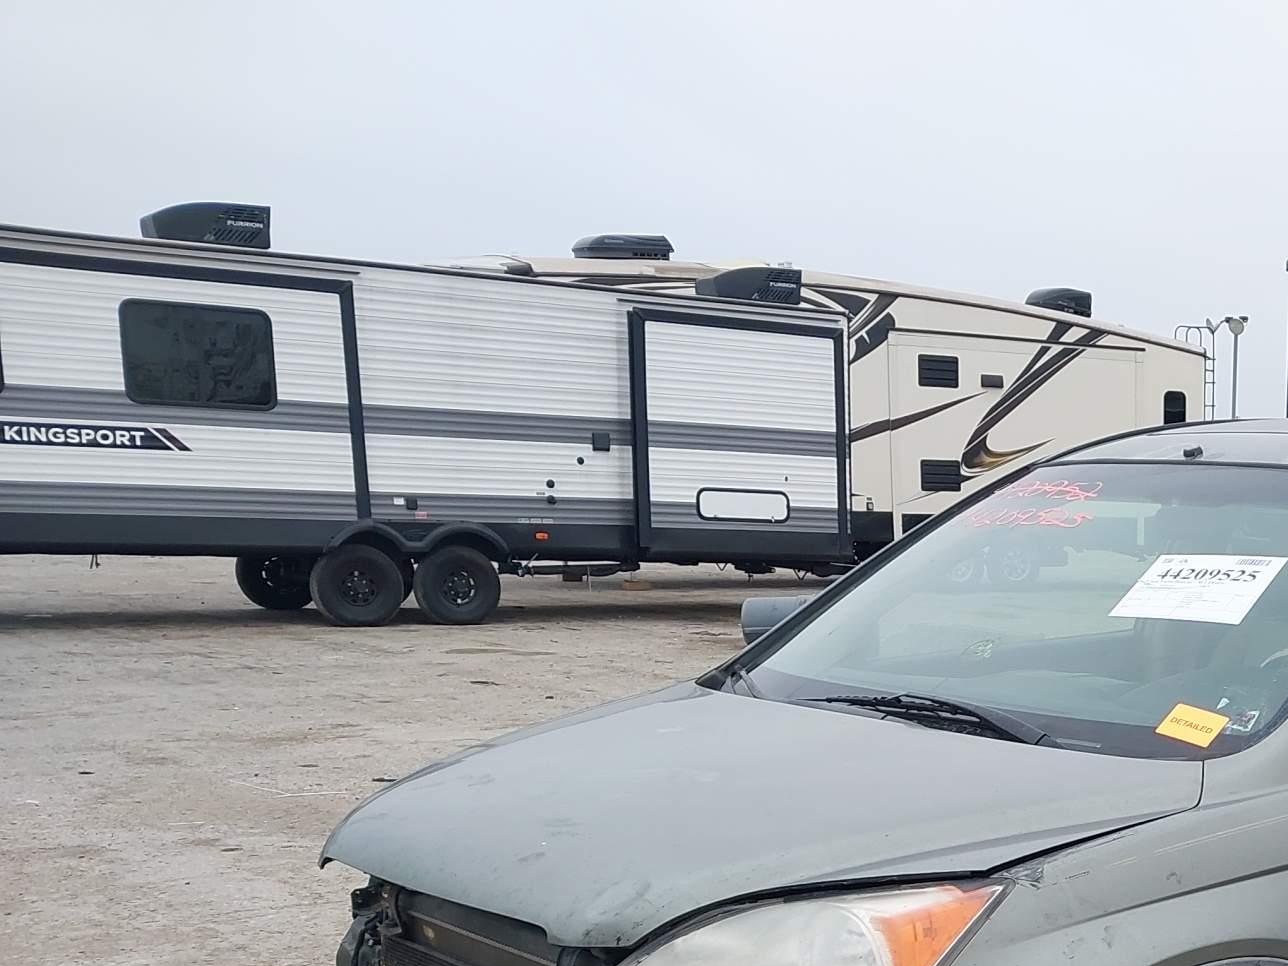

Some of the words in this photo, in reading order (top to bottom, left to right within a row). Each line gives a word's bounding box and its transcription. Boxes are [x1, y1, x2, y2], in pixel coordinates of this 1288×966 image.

[226, 219, 264, 229] FURRION
[3, 425, 145, 446] KINGSPORT
[1156, 567, 1262, 583] 44209525
[1169, 716, 1214, 735] DETAILED
